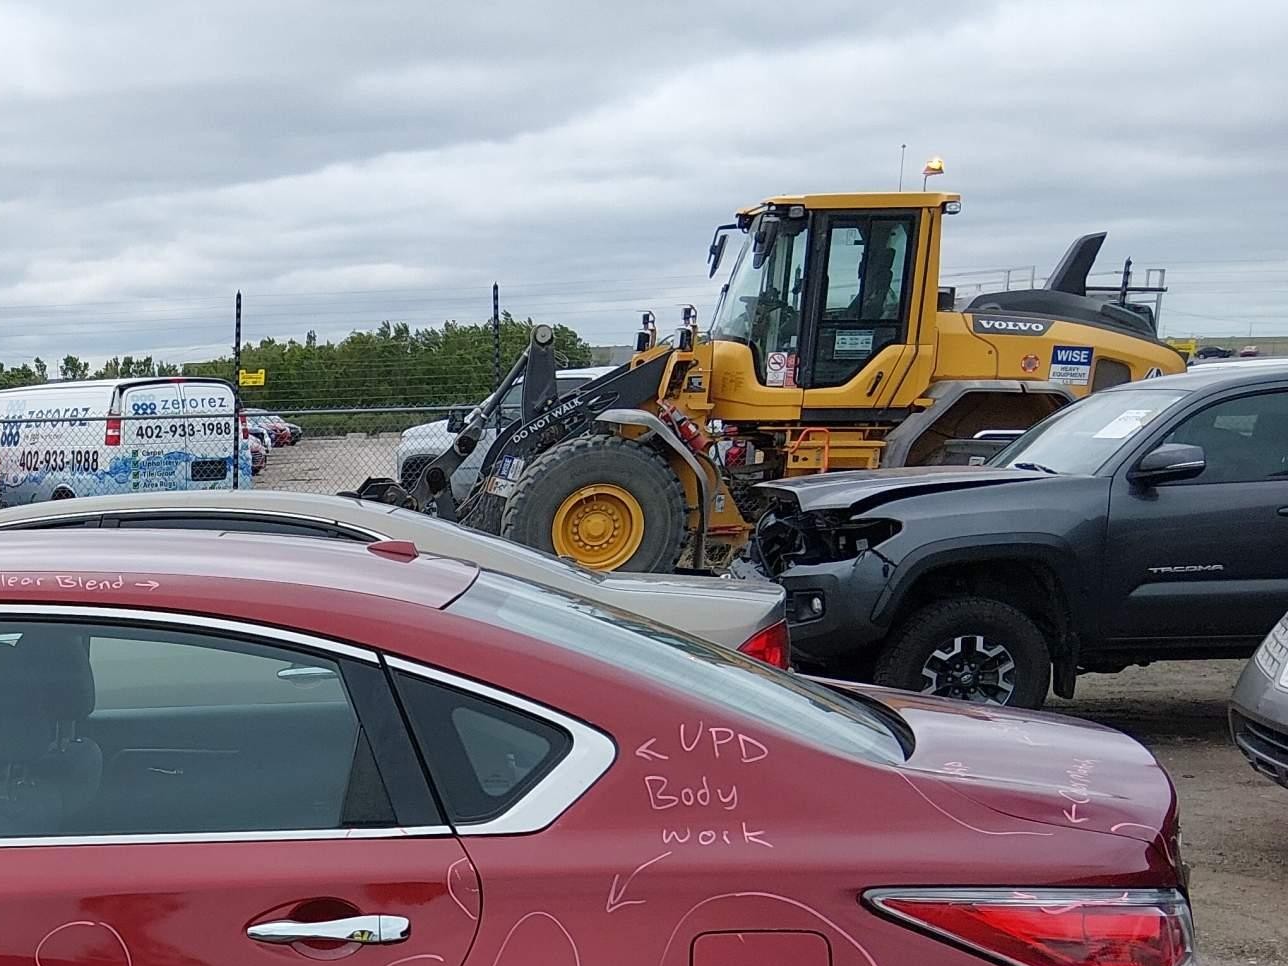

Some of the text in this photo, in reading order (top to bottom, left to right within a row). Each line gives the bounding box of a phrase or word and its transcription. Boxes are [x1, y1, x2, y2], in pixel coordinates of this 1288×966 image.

[978, 319, 1044, 331] VOLVO
[1057, 349, 1089, 363] WISE
[160, 397, 227, 410] zerorez
[513, 397, 584, 443] DO NOT WALK
[136, 421, 231, 439] 402-933-1988
[19, 450, 99, 472] 402-933-1988
[1148, 564, 1224, 573] TACOMA
[55, 575, 124, 590] Blend
[679, 720, 769, 763] UPD
[644, 775, 738, 810] Body
